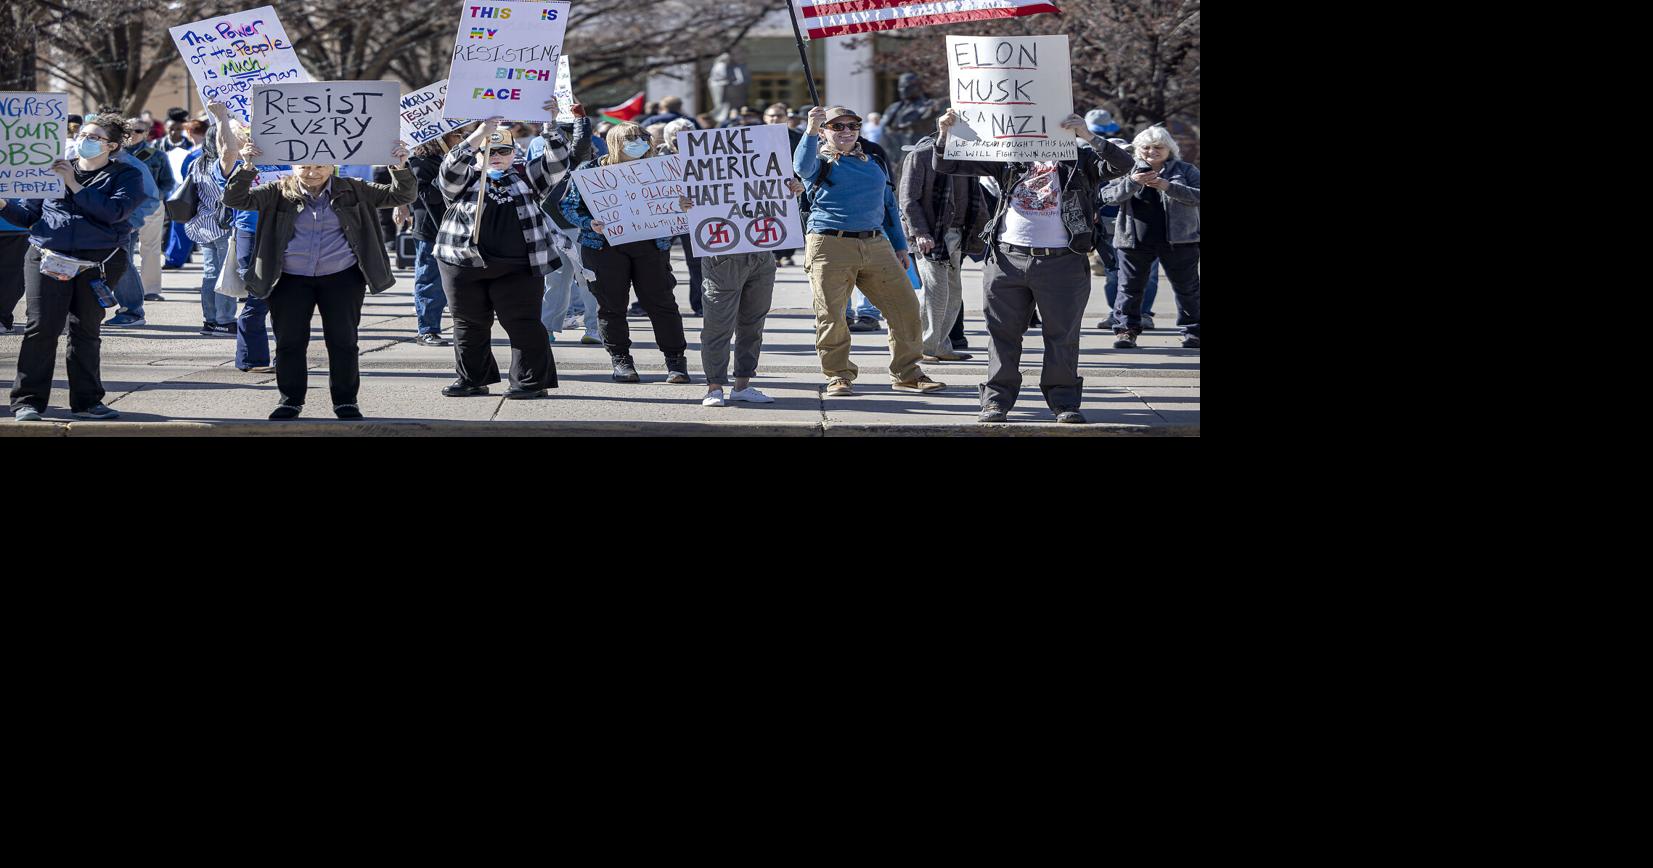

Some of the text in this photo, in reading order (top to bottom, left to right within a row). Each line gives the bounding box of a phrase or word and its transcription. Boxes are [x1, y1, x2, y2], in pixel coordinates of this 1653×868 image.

[470, 6, 558, 20] THIS IS
[181, 20, 264, 46] The Power
[470, 27, 498, 40] MY
[190, 33, 292, 65] of the People
[454, 44, 560, 65] RESISTING
[954, 41, 1038, 68] ELON
[202, 68, 298, 99] Greater than
[203, 69, 218, 80] is
[495, 67, 550, 81] BITCH
[258, 88, 384, 115] RESIST
[400, 91, 435, 110] WORLD
[472, 88, 521, 100] FACE
[957, 78, 1034, 102] MUSK
[400, 105, 433, 124] TESLA
[958, 109, 1047, 137] IS A NAZI
[259, 116, 373, 140] EVERY
[409, 121, 445, 144] PUSSY
[275, 138, 363, 162] DAY
[687, 128, 755, 156] MAKE
[947, 149, 962, 158] WE
[965, 150, 991, 158] WILL
[1001, 139, 1034, 148] FOUGHT
[1037, 139, 1057, 148] THIS
[581, 169, 618, 193] NO
[629, 155, 682, 185] ELON
[683, 151, 783, 182] AMERICA
[13, 179, 61, 193] PEOPLE!
[687, 178, 796, 206] HATE NAZIS
[593, 193, 618, 213] NO
[625, 190, 637, 202] to
[727, 200, 787, 219] AGAIN
[600, 210, 620, 223] NO
[629, 207, 640, 216] to
[607, 225, 624, 237] NO
[632, 222, 642, 232] to
[644, 221, 658, 229] ALL
[658, 219, 676, 227] THIS
